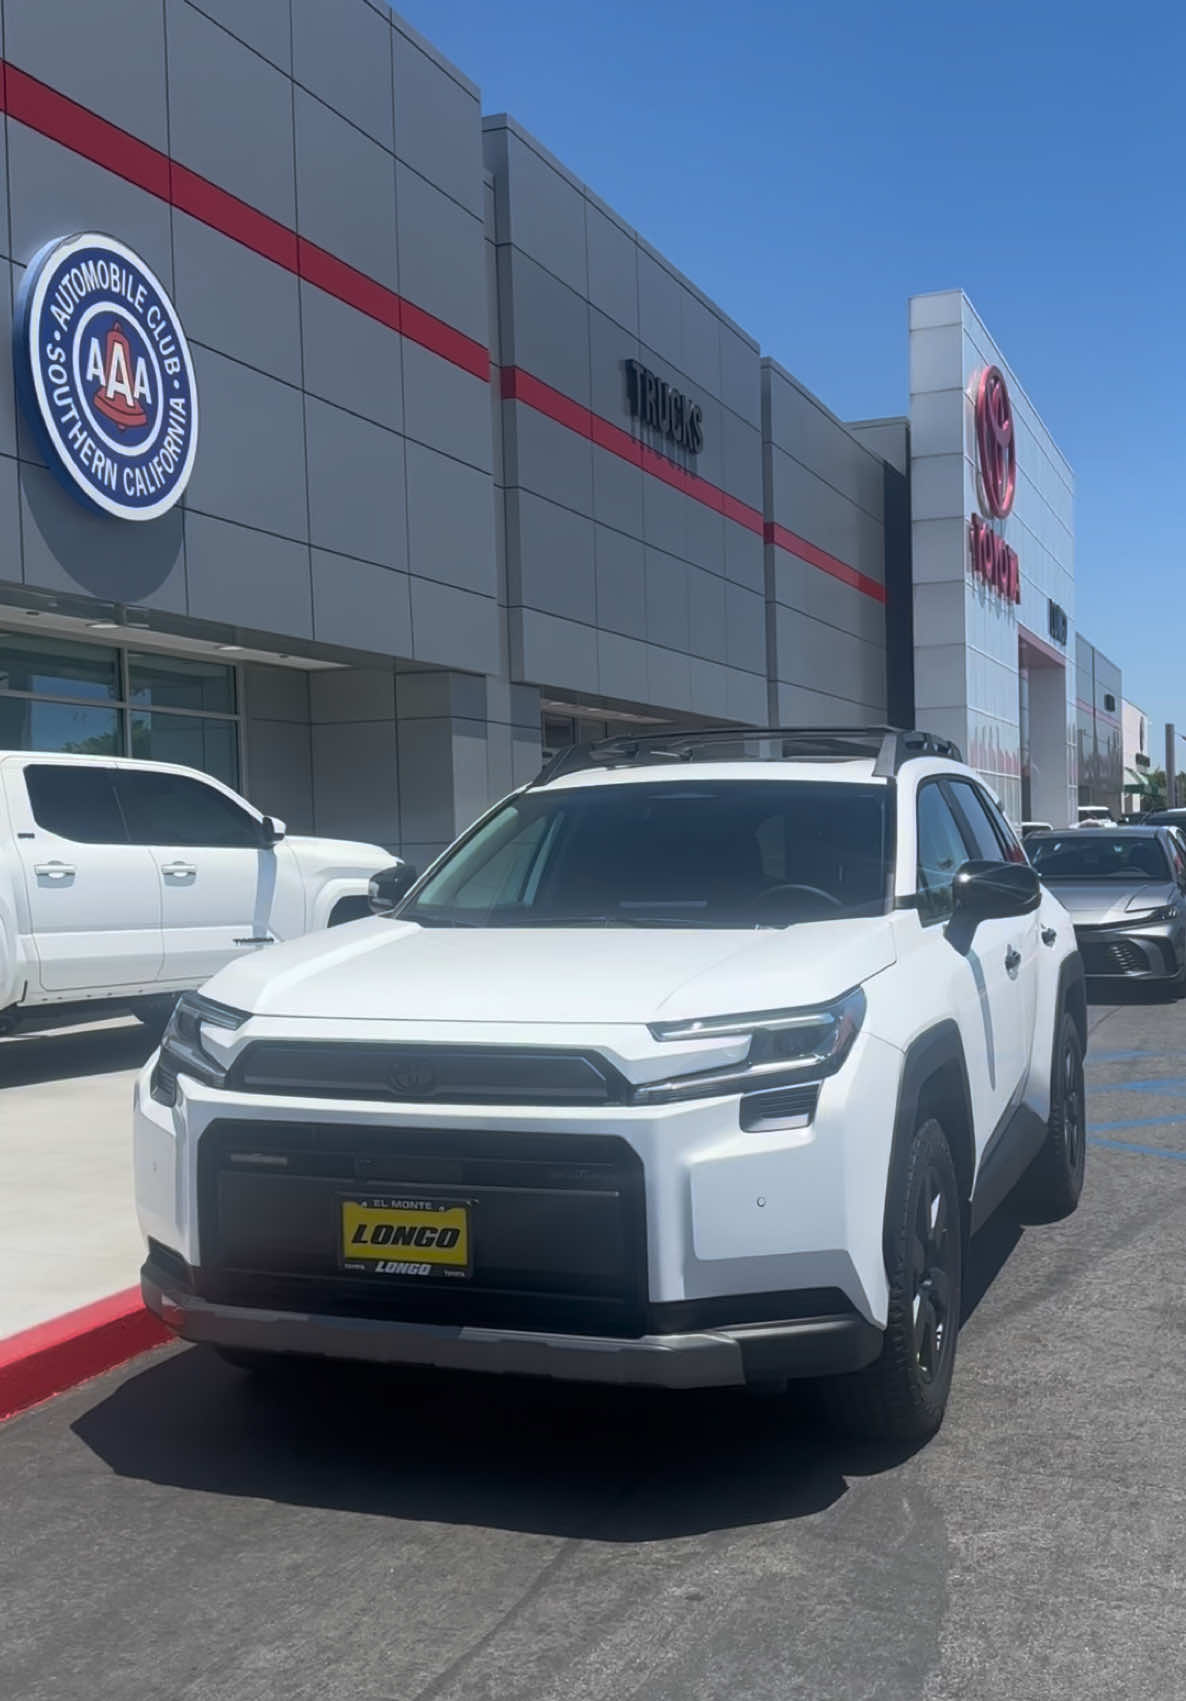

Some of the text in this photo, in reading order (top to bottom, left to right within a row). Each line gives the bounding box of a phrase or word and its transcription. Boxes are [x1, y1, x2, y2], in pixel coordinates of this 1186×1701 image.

[50, 260, 181, 376] AUTOMOBILE CLUB
[86, 337, 152, 407] AAA
[47, 343, 186, 497] SOUTHERN CALIFORNIA
[624, 359, 703, 456] TRUCKS
[352, 1223, 461, 1249] LONGO
[373, 1199, 432, 1210] EL MONTE
[375, 1260, 432, 1276] LONGO
